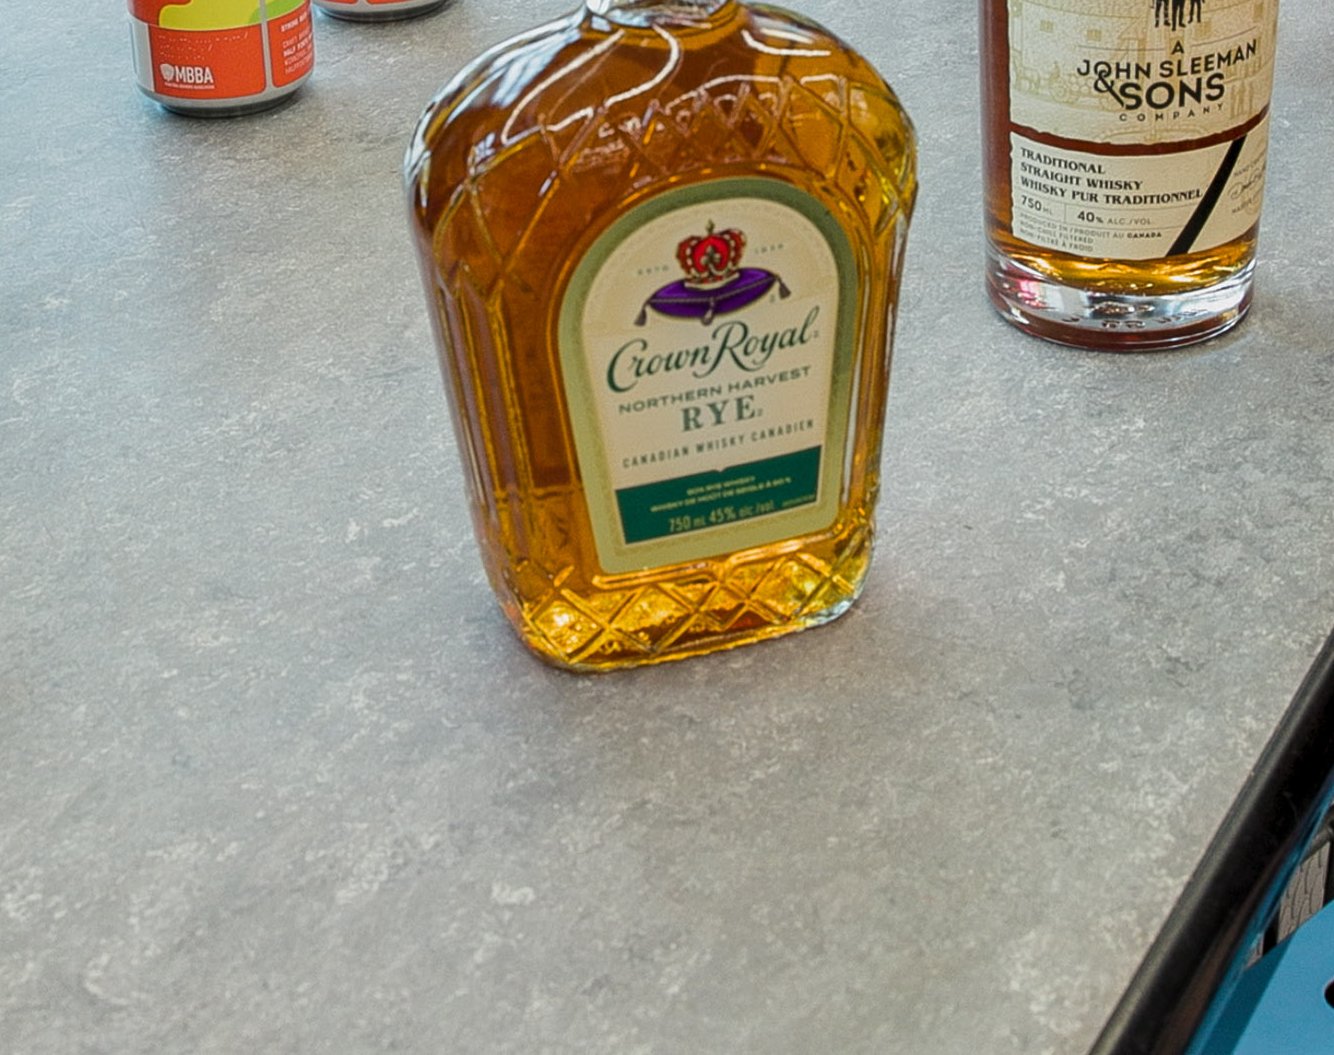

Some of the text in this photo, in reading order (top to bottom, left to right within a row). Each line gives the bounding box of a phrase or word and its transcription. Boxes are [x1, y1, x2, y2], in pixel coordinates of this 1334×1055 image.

[1077, 38, 1258, 80] JOHN SLEEMAN
[1171, 40, 1185, 55] A
[174, 65, 215, 84] MBBA
[1093, 69, 1226, 111] & SONS
[1119, 102, 1224, 123] COMPANY
[1020, 147, 1107, 175] TRADITIONAL
[1020, 162, 1144, 191] STRAIGHT WHISKY
[1020, 176, 1204, 206] WHISKY PUR TRADITIONNEL
[1020, 195, 1043, 212] 750
[1077, 211, 1104, 224] 40%
[607, 305, 820, 394] Crown Royal
[619, 364, 812, 414] NORTHERN HARVEST
[681, 394, 757, 433] RYE
[622, 418, 815, 469] CANADIAN WHISKY CANADIEN
[669, 515, 691, 533] 750
[708, 506, 737, 523] 45%
